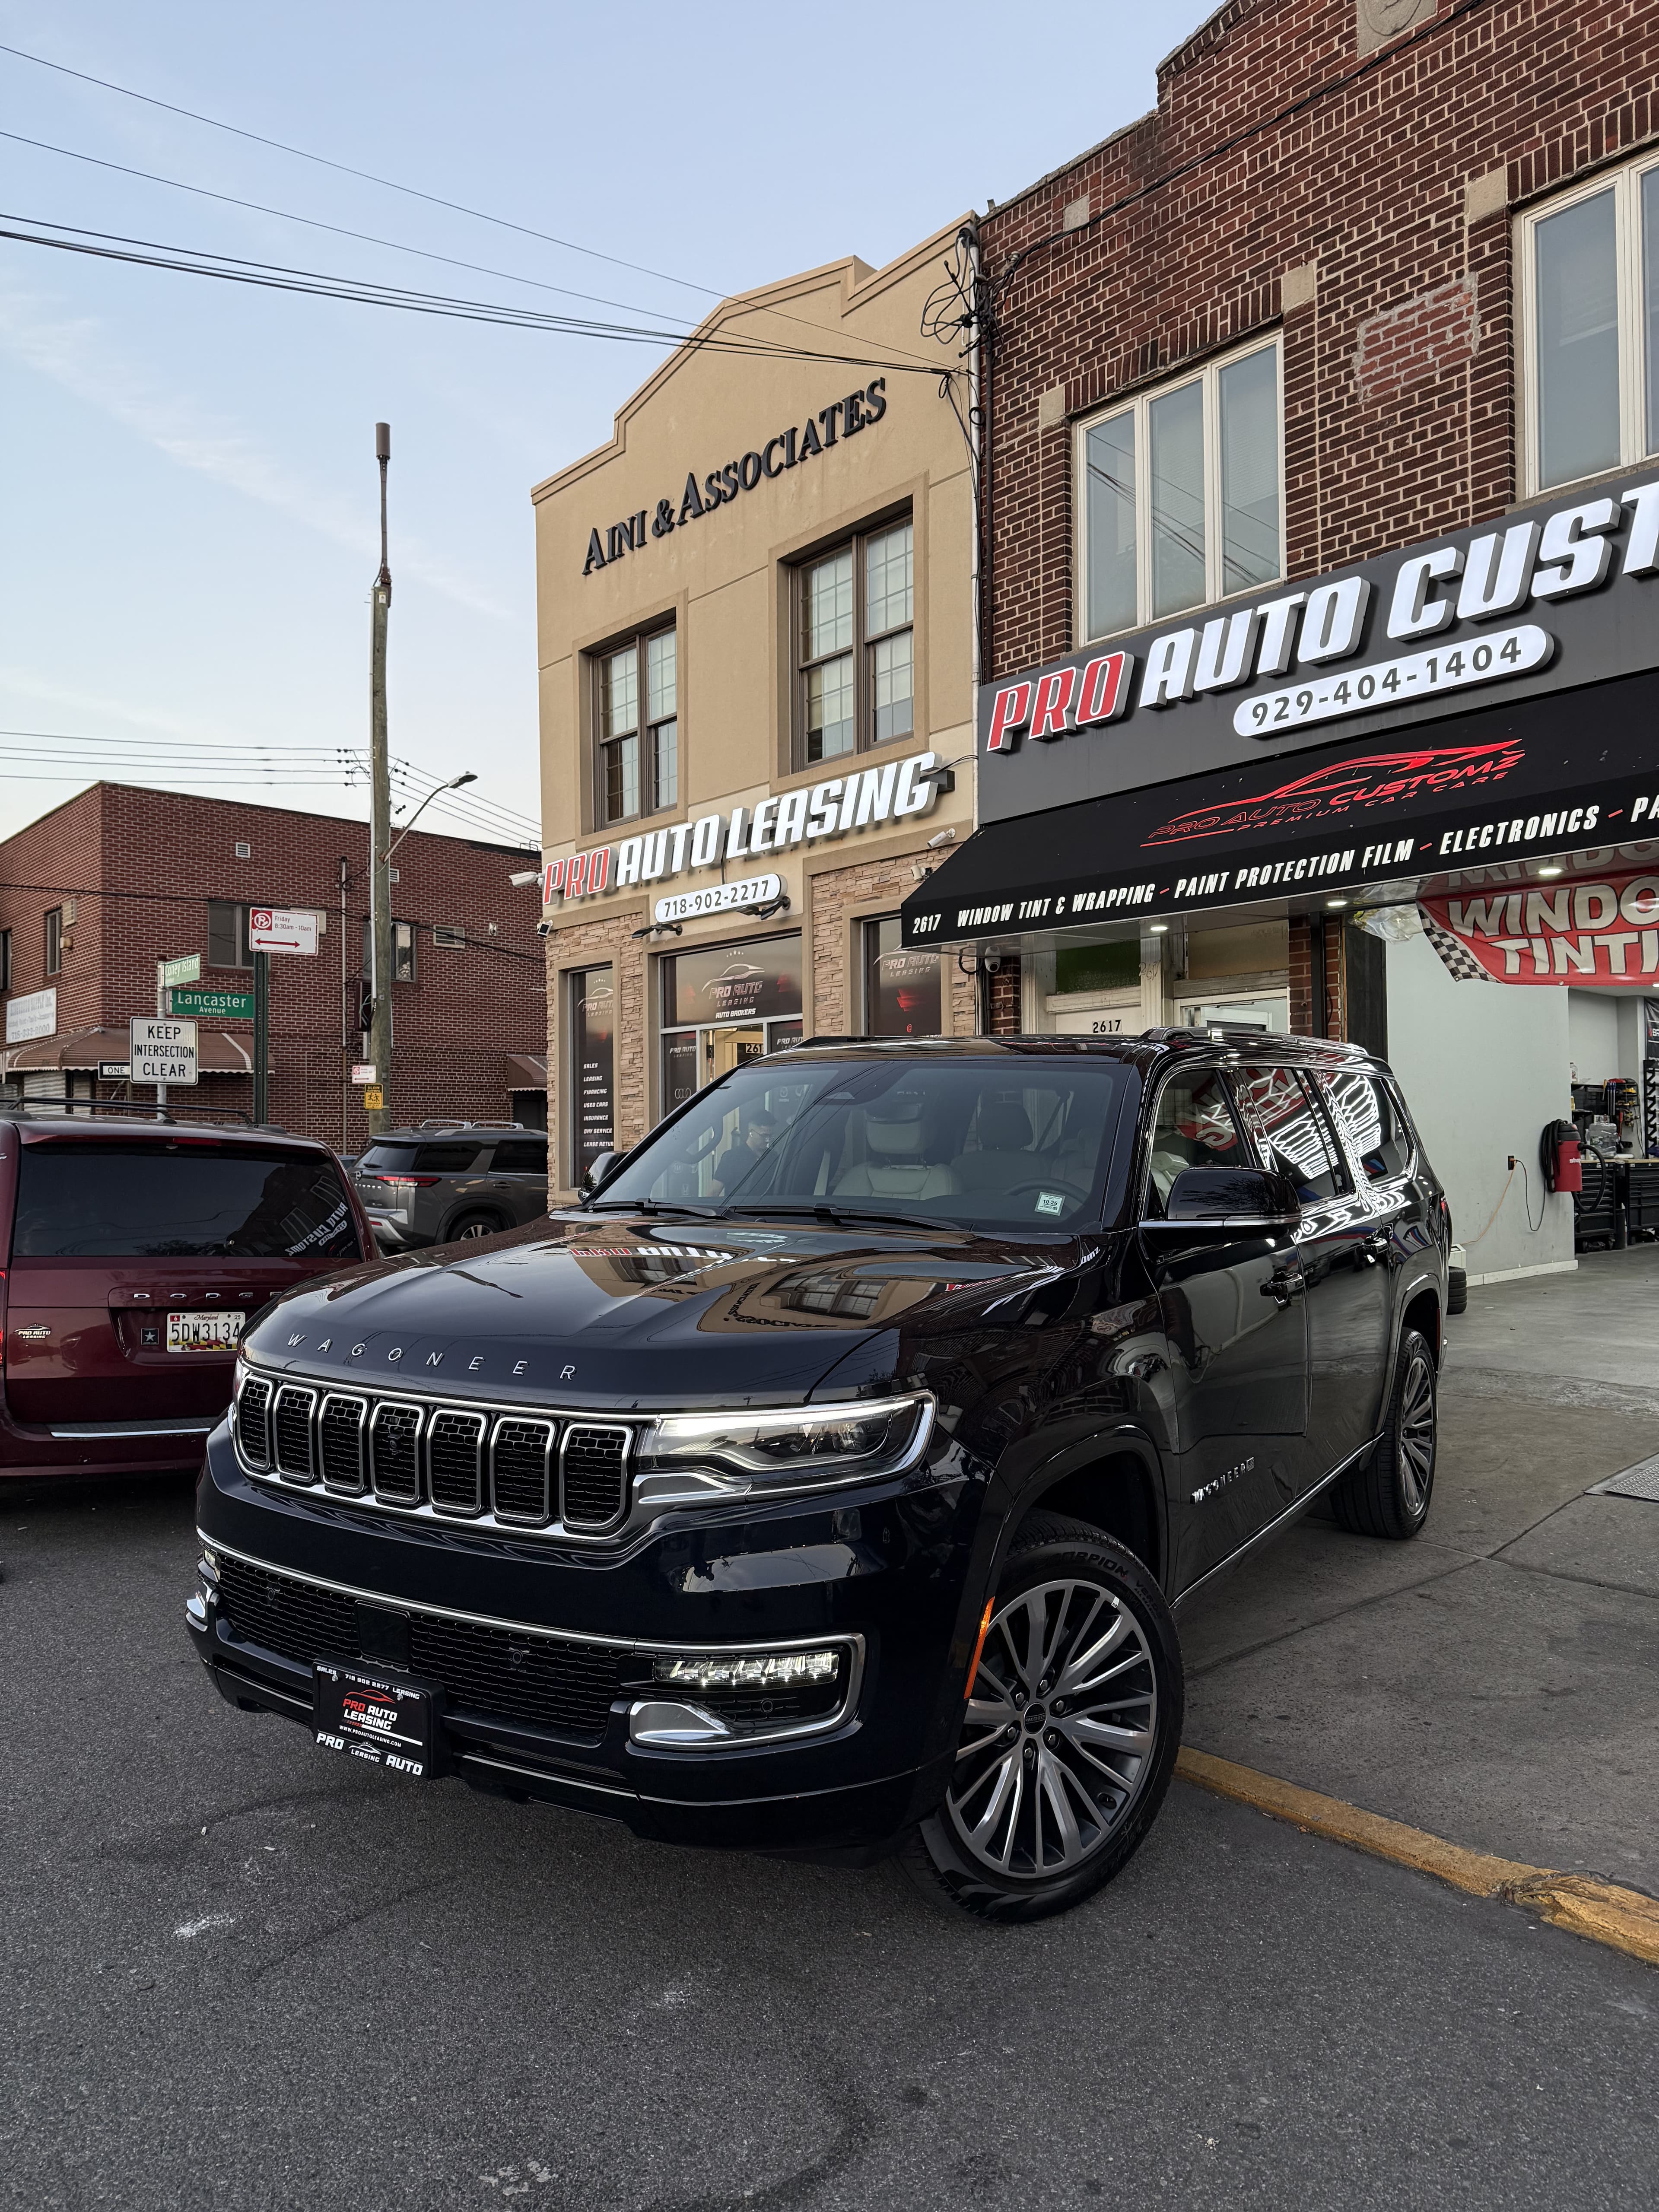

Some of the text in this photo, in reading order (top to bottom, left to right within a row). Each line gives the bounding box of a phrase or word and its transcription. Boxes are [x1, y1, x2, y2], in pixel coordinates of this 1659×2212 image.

[582, 377, 887, 575] AINI & ASSOCIATES
[987, 481, 1659, 752] PRO AUTO CUST
[1251, 636, 1522, 728] 929-404-1404
[1236, 772, 1509, 832] PREMIUM CAR CARE
[543, 751, 940, 905] PRO AUTO LEASING
[1148, 816, 1219, 839] PRO
[1223, 799, 1321, 824] AUTO
[912, 913, 942, 934] 2617
[957, 903, 1014, 928] WINDOW
[1018, 897, 1050, 919] TINT
[1055, 896, 1065, 915] &
[1072, 883, 1155, 912] WRAPPING
[1174, 872, 1230, 899] PAINT
[1234, 849, 1354, 890] PROTECTION
[1362, 839, 1415, 868] FILM
[1439, 805, 1600, 855] ELECTRONICS
[664, 879, 769, 918] 718-902-2277
[1447, 875, 1659, 938] WINDO
[882, 953, 939, 971] PRO AUTO
[1488, 929, 1659, 975] TINTI
[165, 958, 198, 977] Coney Island
[890, 967, 931, 978] LEASING
[178, 992, 246, 1008] Lancaster
[709, 981, 763, 999] PRO AUTO
[717, 996, 754, 1007] LEASING
[199, 1006, 226, 1014] Avenue
[730, 1008, 756, 1017] BROKERS
[148, 1025, 181, 1039] KEEP
[1093, 1020, 1122, 1034] 2617
[134, 1044, 194, 1058] INTERSECTION
[143, 1062, 186, 1077] CLEAR
[171, 1322, 239, 1342] 5DW3134
[287, 1333, 577, 1381] WAGONEER
[317, 1665, 337, 1675] SALES
[357, 1677, 370, 1685] 902
[372, 1681, 389, 1690] 2277
[392, 1687, 420, 1700] LEASING
[343, 1698, 398, 1722] PRO AUTO
[343, 1709, 392, 1730] LEASING
[339, 1725, 401, 1748] WWW.PROAUTOLEASING.COM
[316, 1732, 423, 1776] PRO LEASING AUTO
